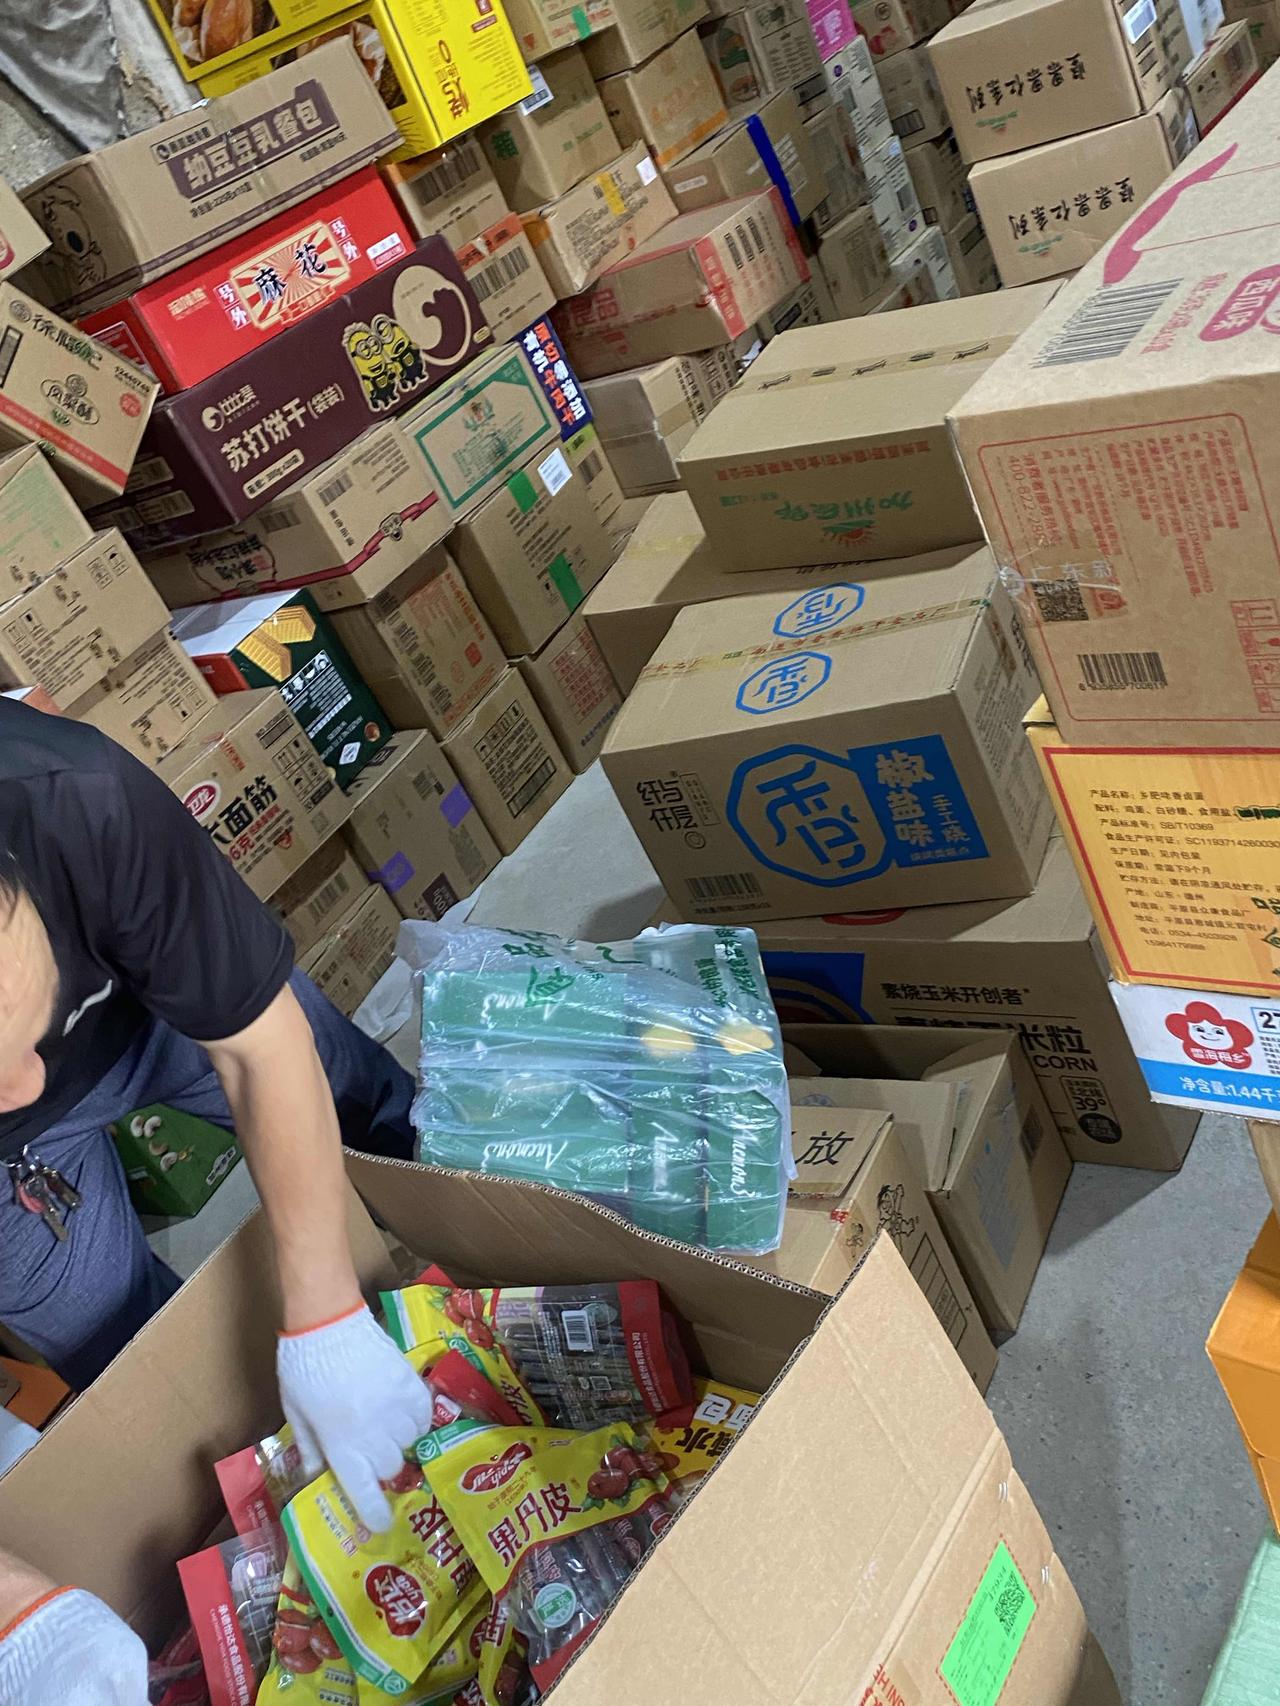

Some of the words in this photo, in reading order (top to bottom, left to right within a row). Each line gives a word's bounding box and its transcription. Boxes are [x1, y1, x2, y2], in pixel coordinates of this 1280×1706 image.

[966, 52, 1087, 113] 坚果果仁系列
[183, 98, 323, 189] 纳豆豆乳餐包
[1008, 176, 1135, 240] 坚果果仁系列
[253, 243, 330, 301] 麻花
[876, 749, 934, 846] 椒盐味
[880, 982, 1024, 1006] 素烧玉米开创者
[1034, 1054, 1099, 1073] CORN
[487, 1481, 583, 1567] 果丹皮
